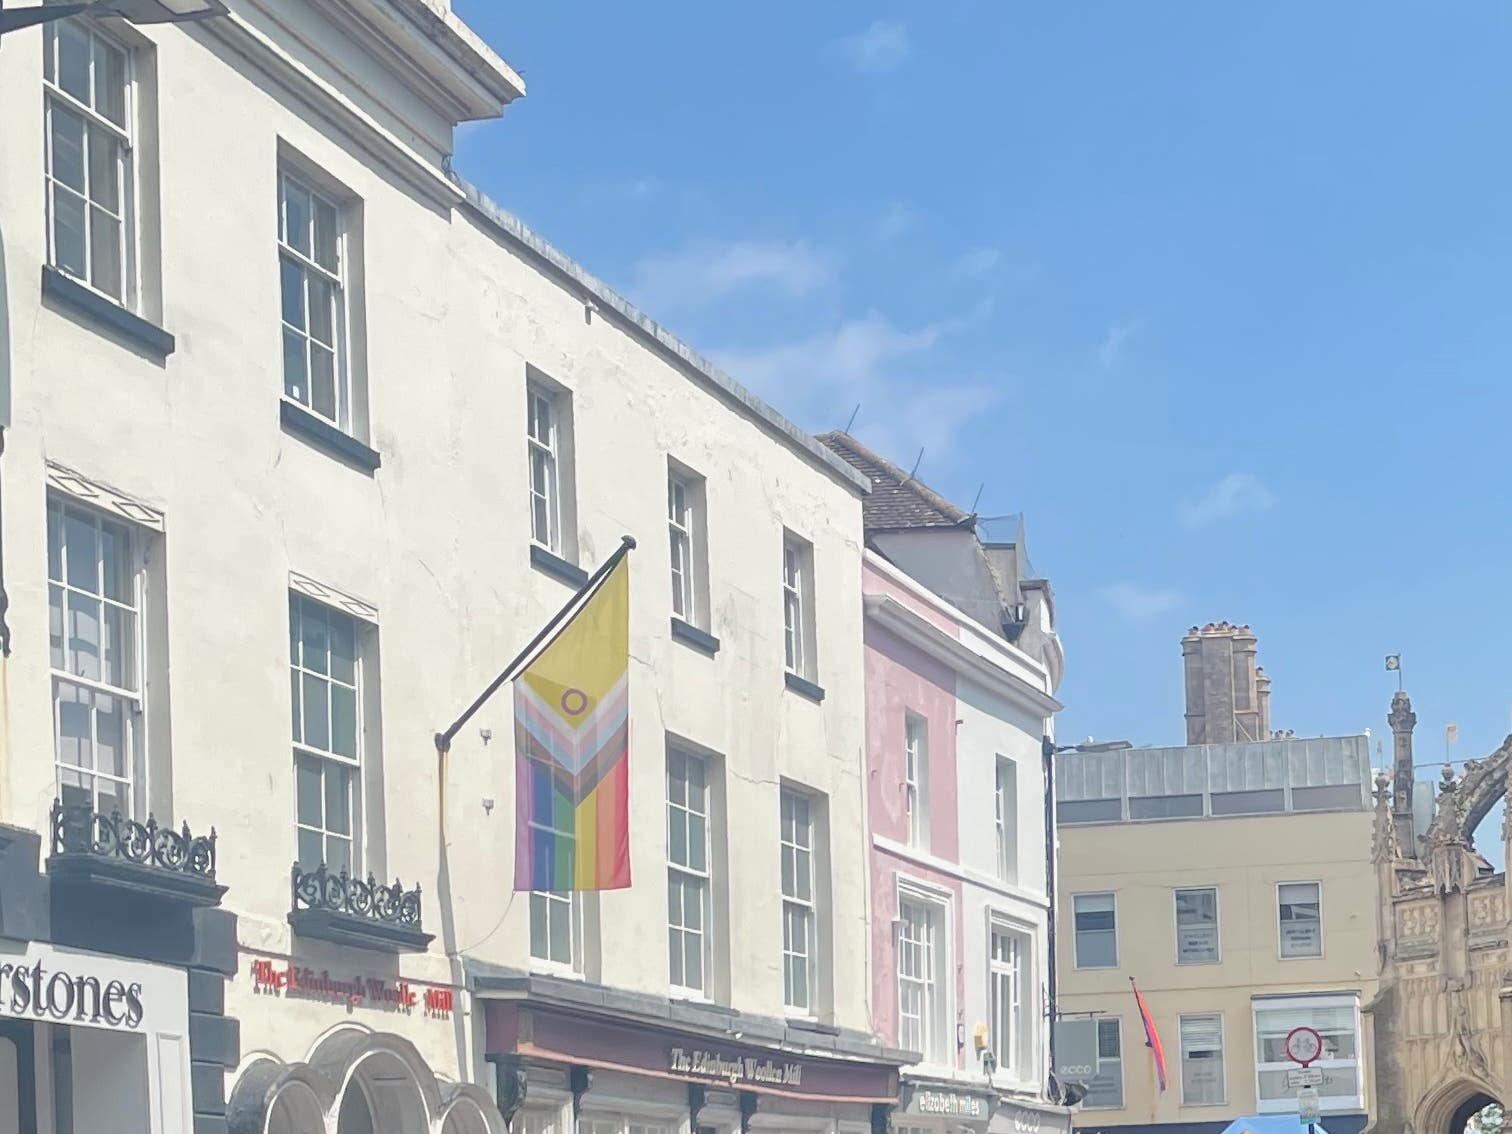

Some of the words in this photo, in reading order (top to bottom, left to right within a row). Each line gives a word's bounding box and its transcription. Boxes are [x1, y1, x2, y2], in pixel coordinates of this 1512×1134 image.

[671, 1047, 691, 1071] The
[692, 1050, 743, 1083] Edinburgh
[744, 1057, 782, 1083] Woollen
[1060, 1064, 1092, 1075] ecco
